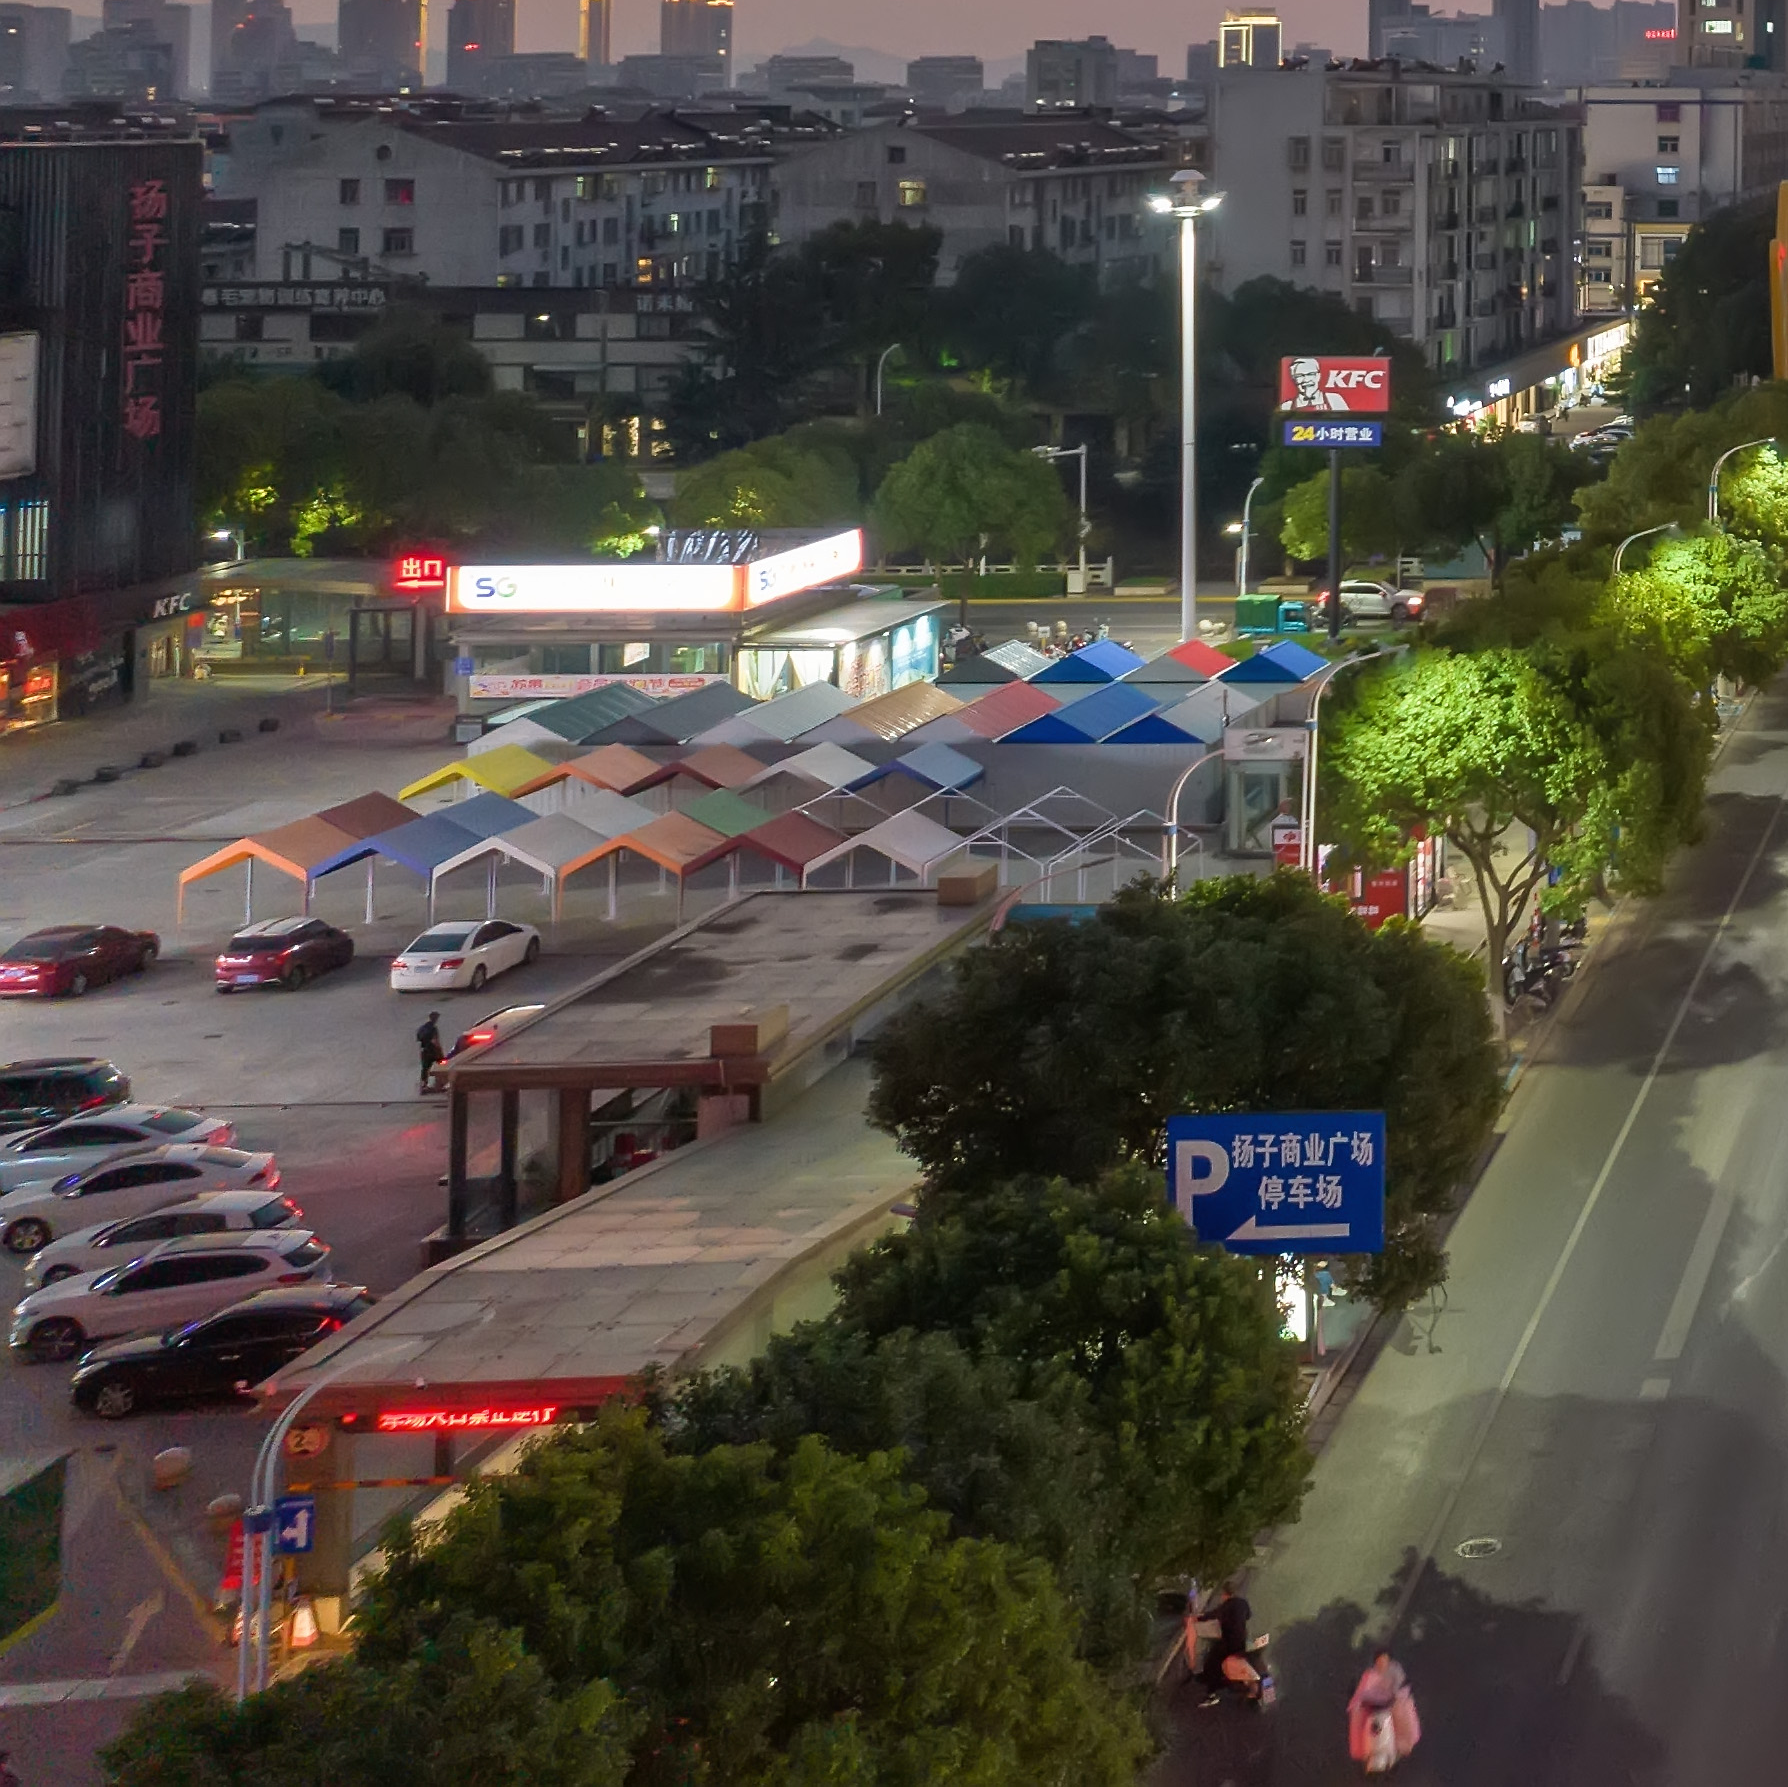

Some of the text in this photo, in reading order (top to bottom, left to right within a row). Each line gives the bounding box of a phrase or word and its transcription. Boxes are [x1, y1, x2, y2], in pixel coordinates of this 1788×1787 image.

[124, 179, 170, 438] 扬子商业广场
[1324, 369, 1386, 389] KFC
[1292, 426, 1374, 442] 24小时营业
[402, 557, 442, 579] 出口
[152, 591, 192, 620] KFC
[1231, 1131, 1374, 1169] 扬子商业广场
[1175, 1139, 1230, 1228] P
[1257, 1174, 1343, 1210] 停车场
